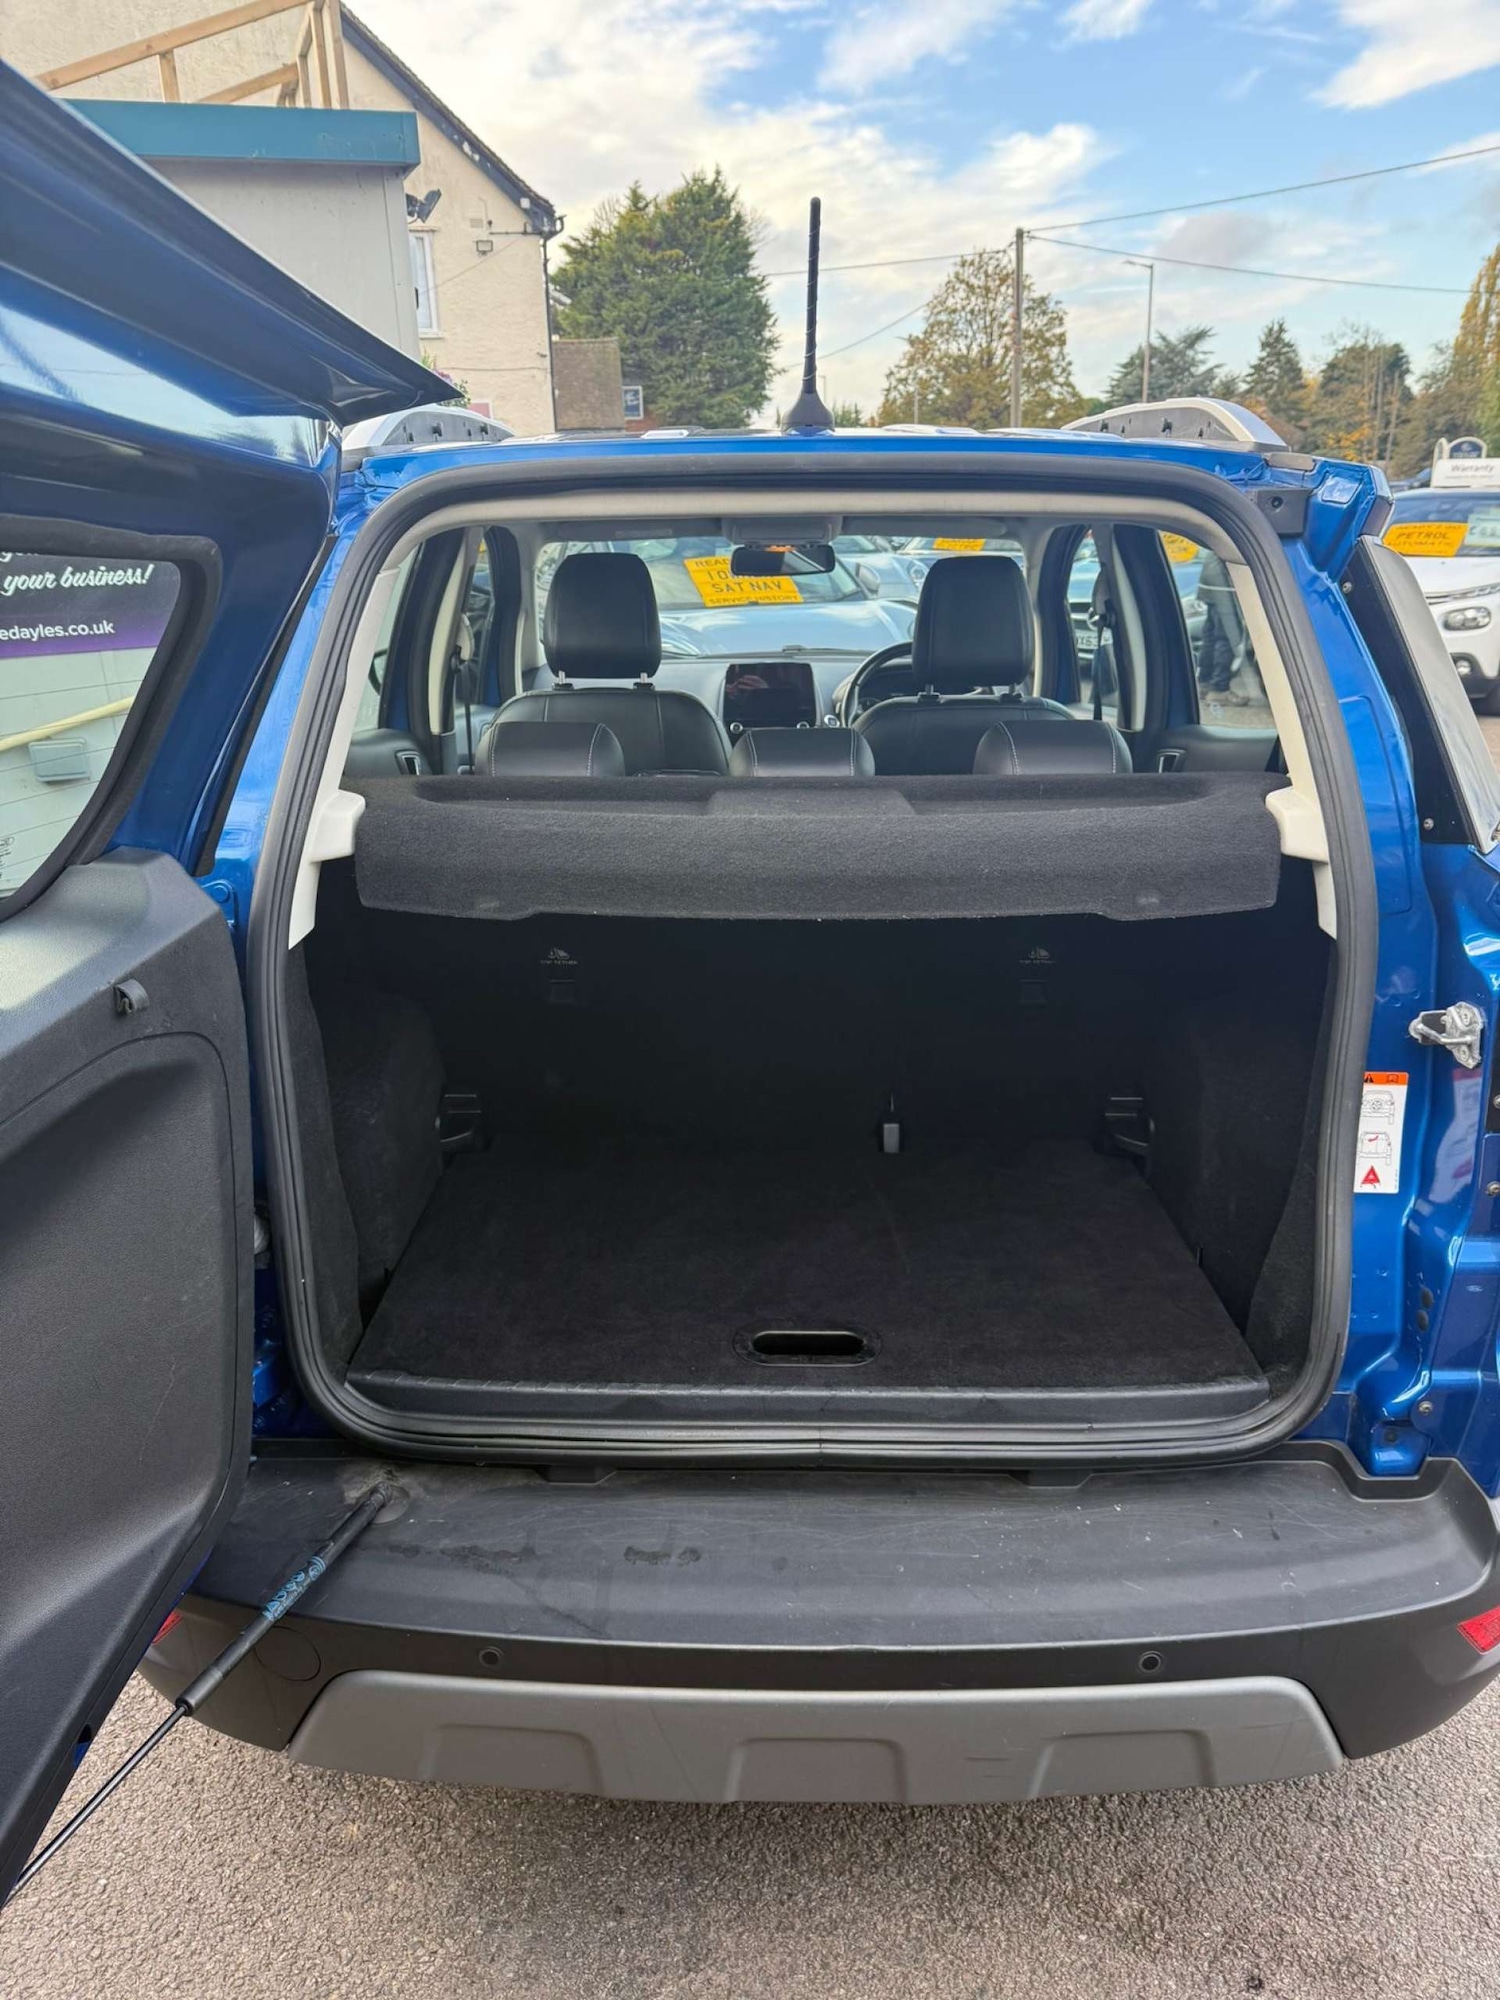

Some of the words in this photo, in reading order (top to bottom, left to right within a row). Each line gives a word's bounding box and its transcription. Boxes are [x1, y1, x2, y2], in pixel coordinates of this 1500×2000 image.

[0, 571, 57, 596] your
[60, 563, 155, 588] business!
[712, 582, 744, 592] SAT
[749, 580, 782, 591] NAV
[0, 620, 115, 642] edayles.co.uk
